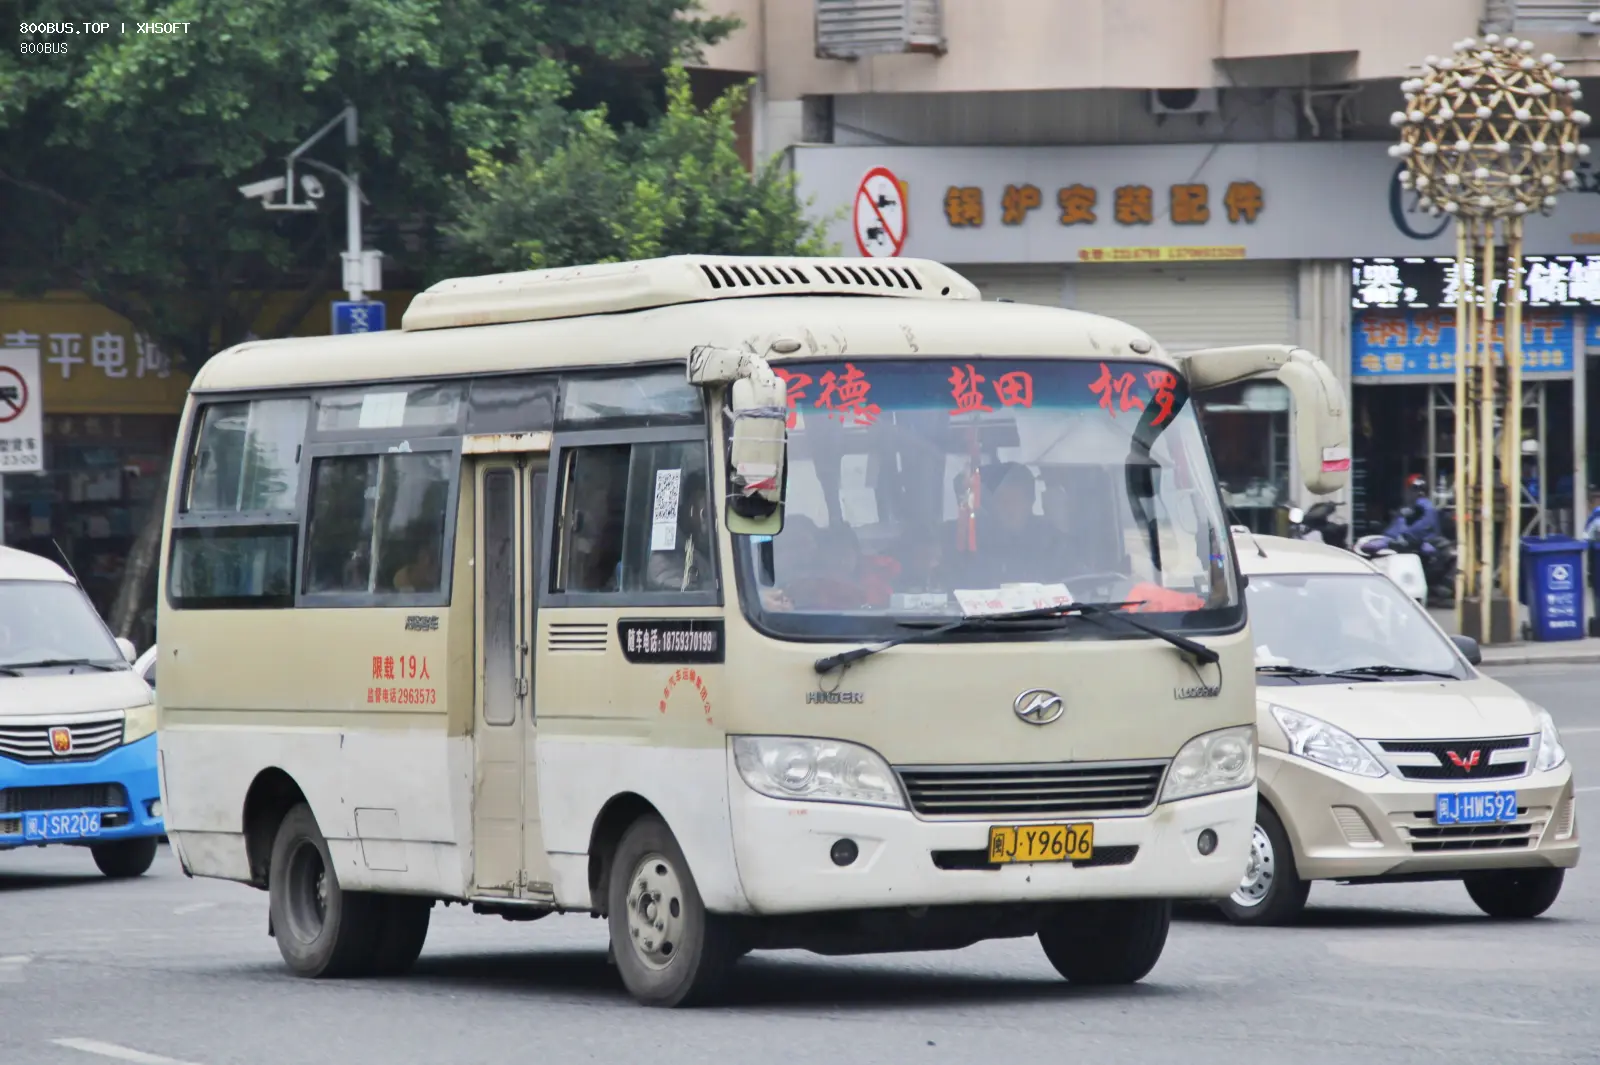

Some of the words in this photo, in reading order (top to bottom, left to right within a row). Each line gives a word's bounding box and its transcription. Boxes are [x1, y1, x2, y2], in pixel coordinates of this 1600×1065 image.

[943, 181, 1265, 228] 锅炉安装配件
[770, 362, 882, 430] 宁德
[947, 363, 1033, 416] 盐田
[1087, 361, 1177, 427] 松罗
[805, 690, 864, 705] HIGER
